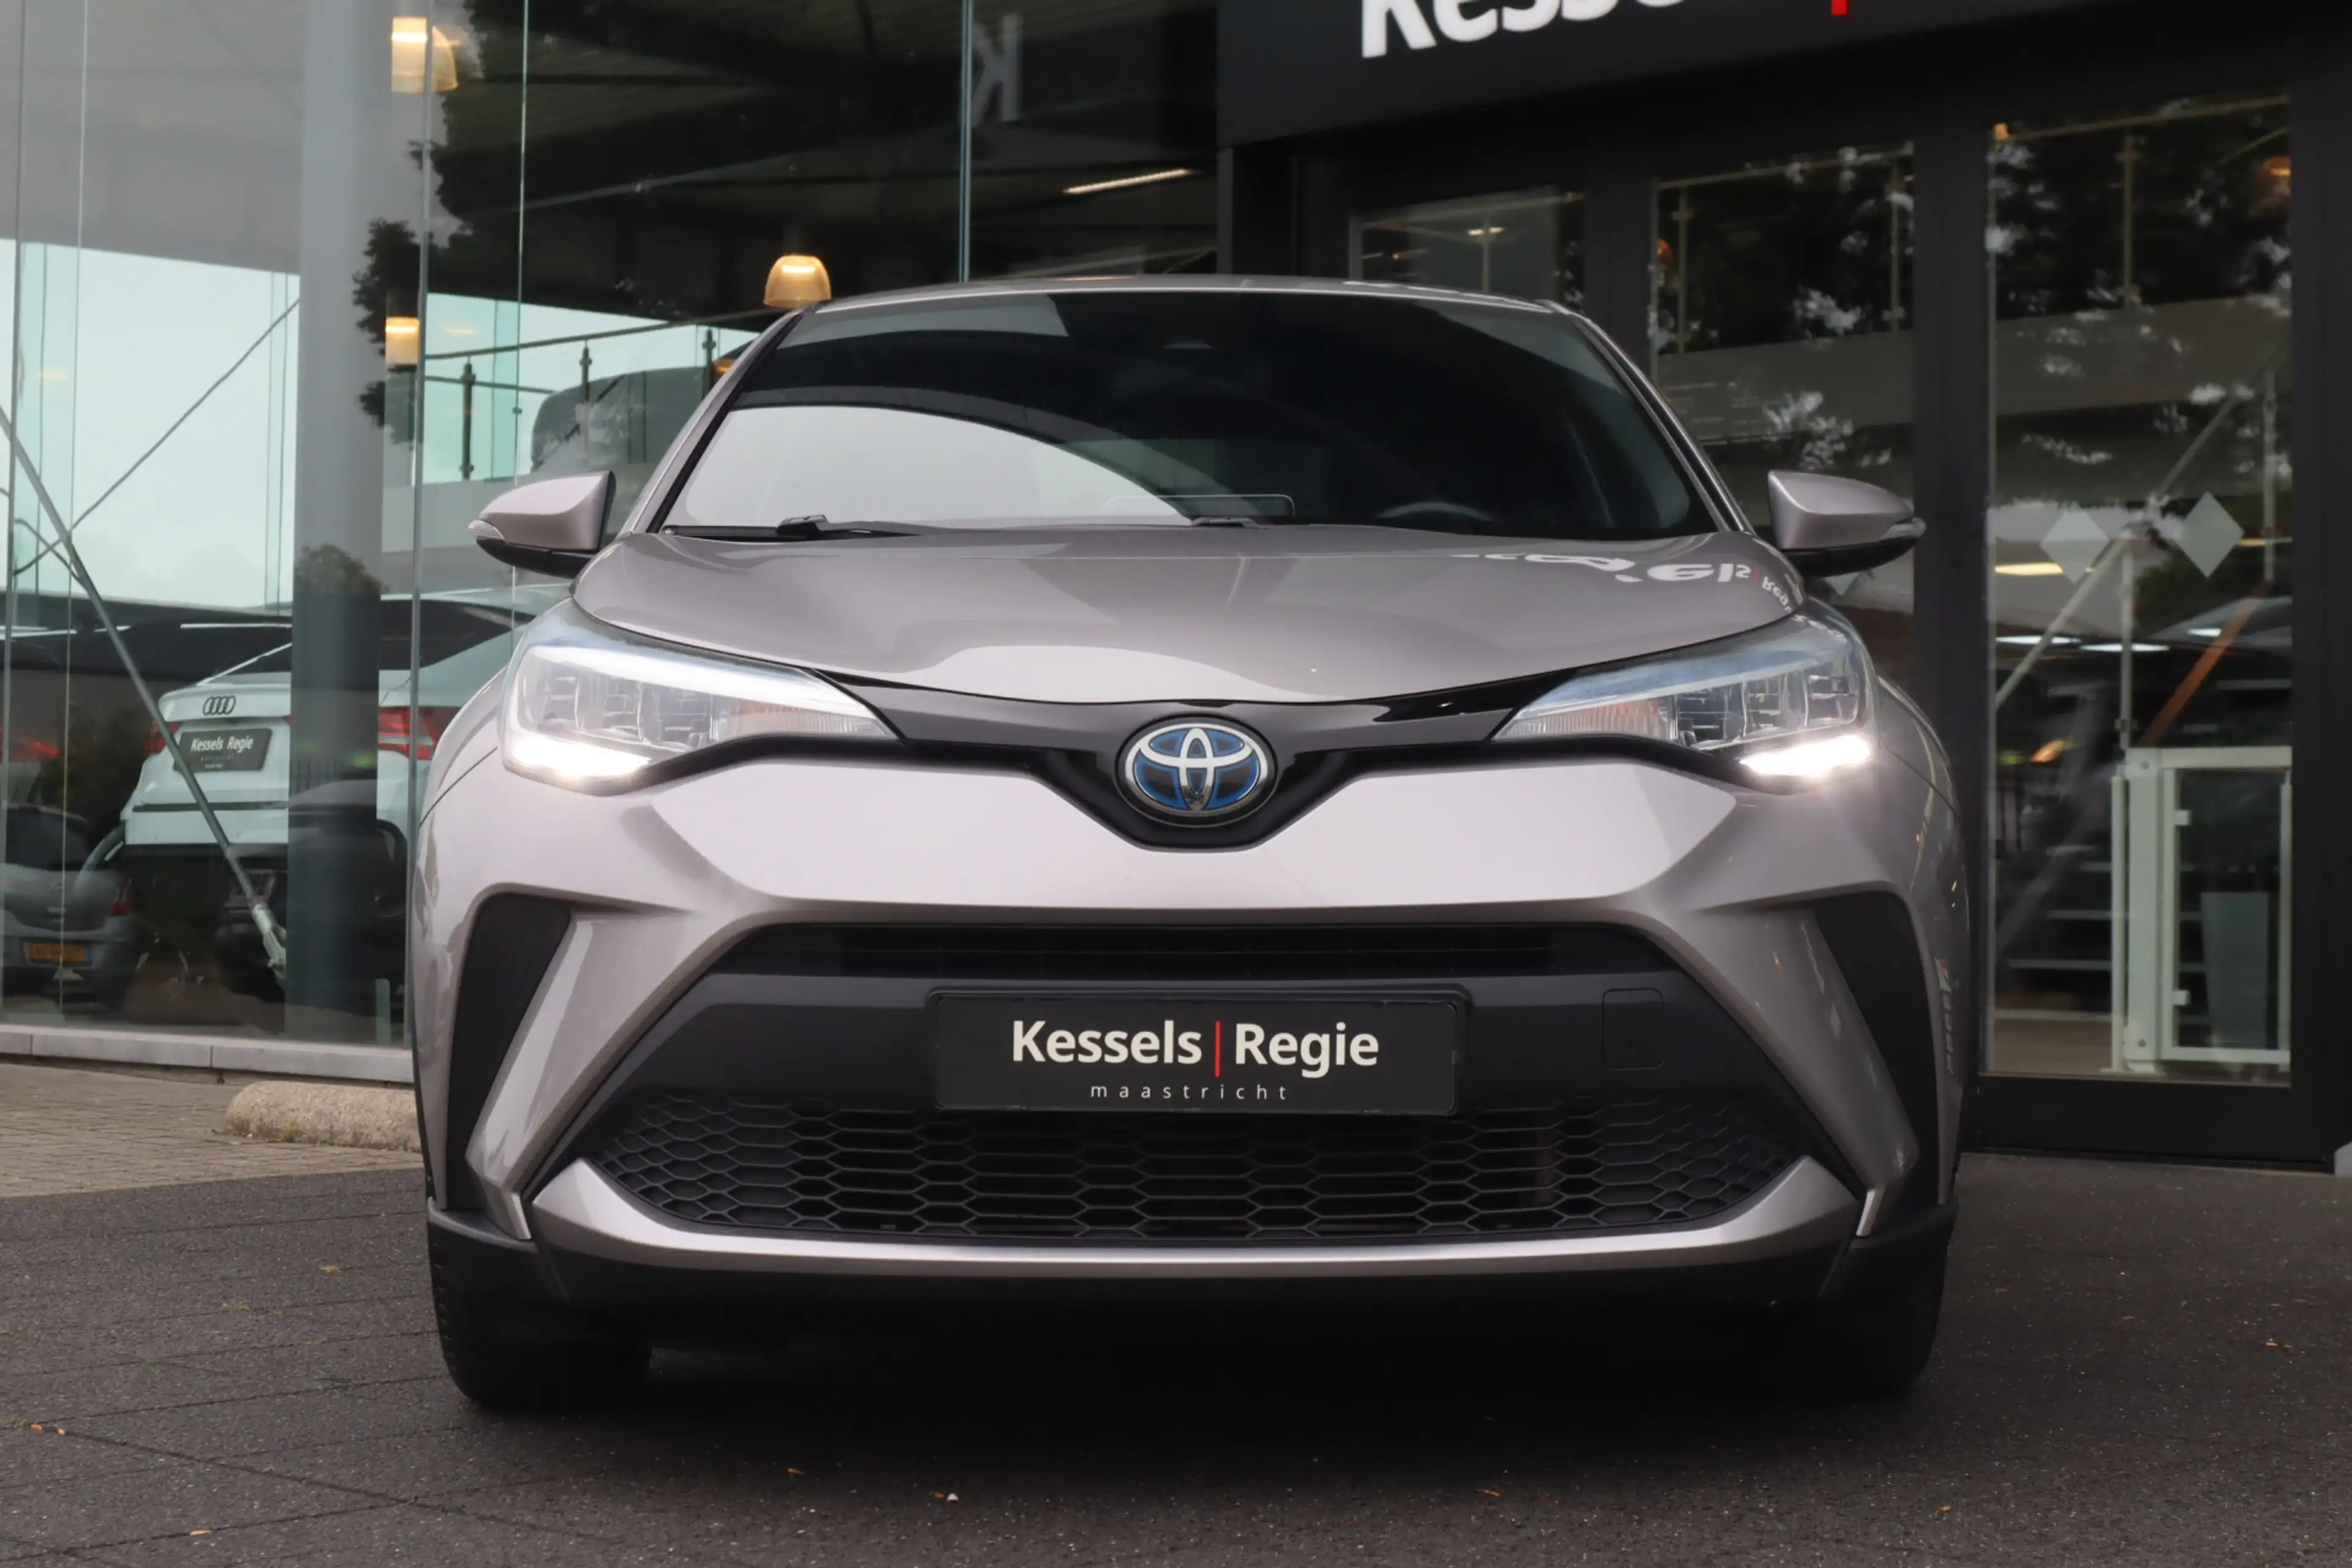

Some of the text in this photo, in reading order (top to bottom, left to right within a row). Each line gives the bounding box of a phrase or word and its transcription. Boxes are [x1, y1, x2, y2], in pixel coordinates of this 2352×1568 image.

[190, 735, 254, 754] Kessels Regie
[1012, 1020, 1379, 1079] Kessels Regie
[1090, 1083, 1287, 1101] maastricht
